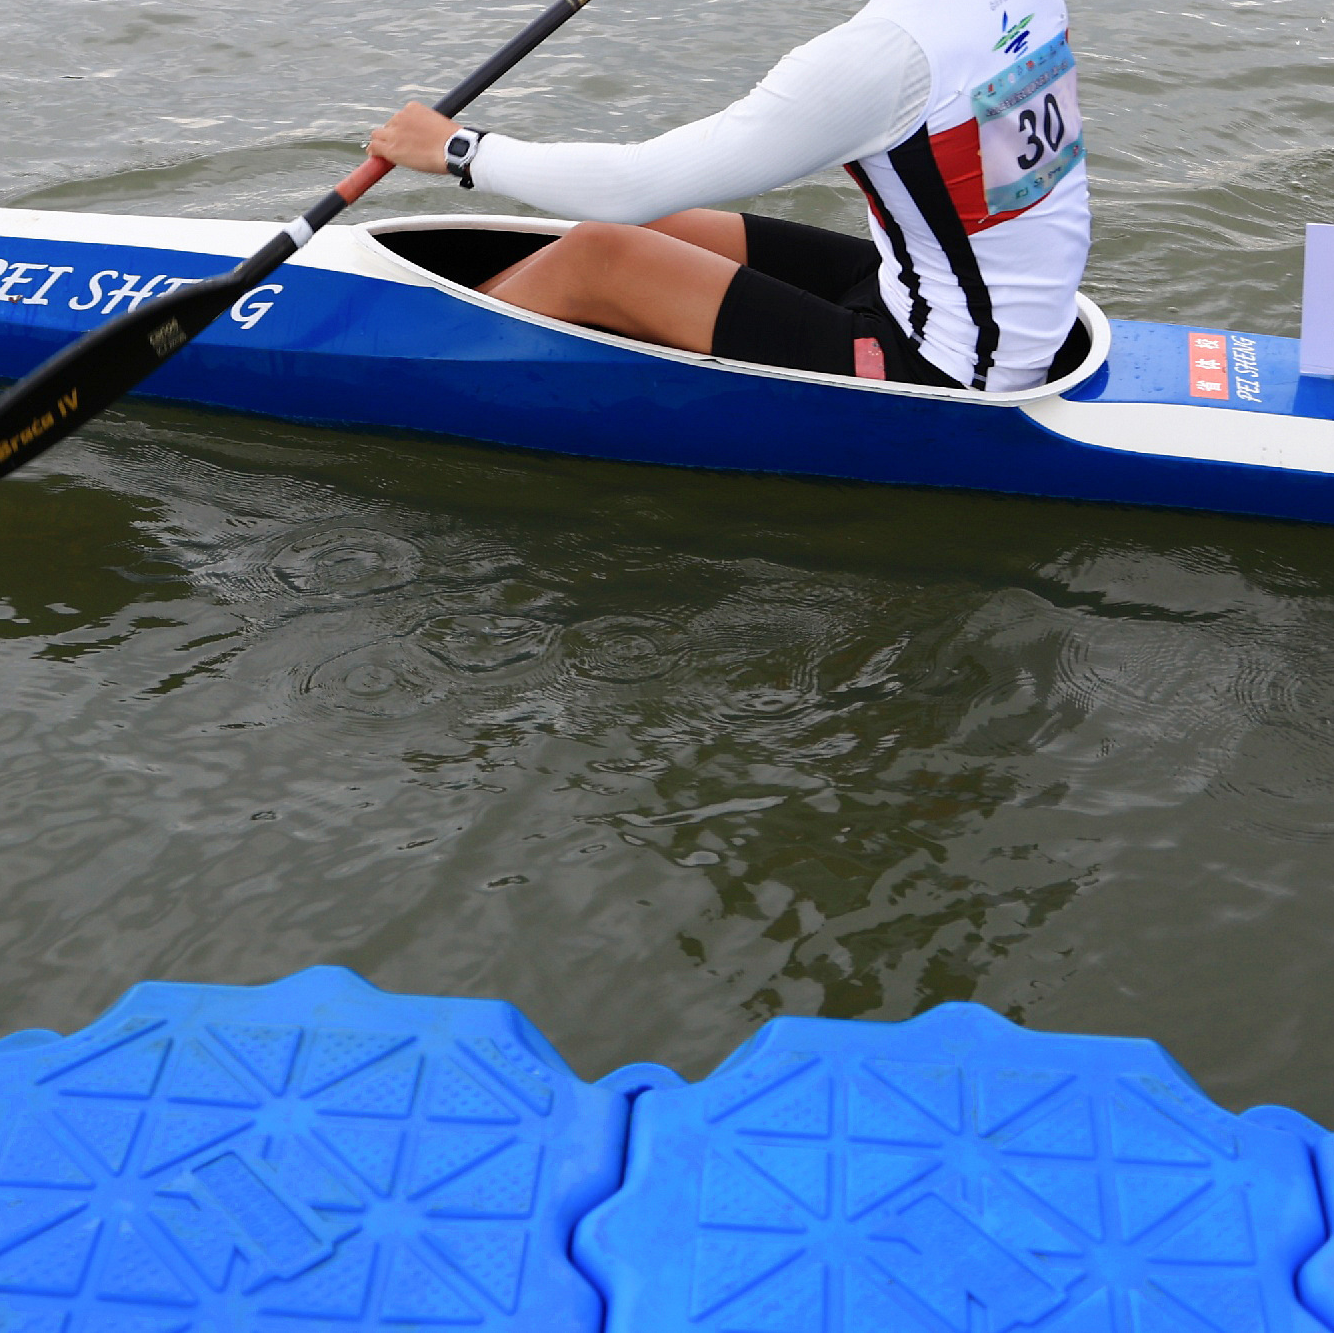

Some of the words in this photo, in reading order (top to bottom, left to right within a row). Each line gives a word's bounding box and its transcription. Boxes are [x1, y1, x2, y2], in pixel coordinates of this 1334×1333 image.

[1017, 93, 1065, 170] 30
[68, 270, 284, 330] SHG
[1230, 335, 1259, 378] SHENG
[57, 386, 78, 419] IV
[1235, 376, 1263, 403] PEI
